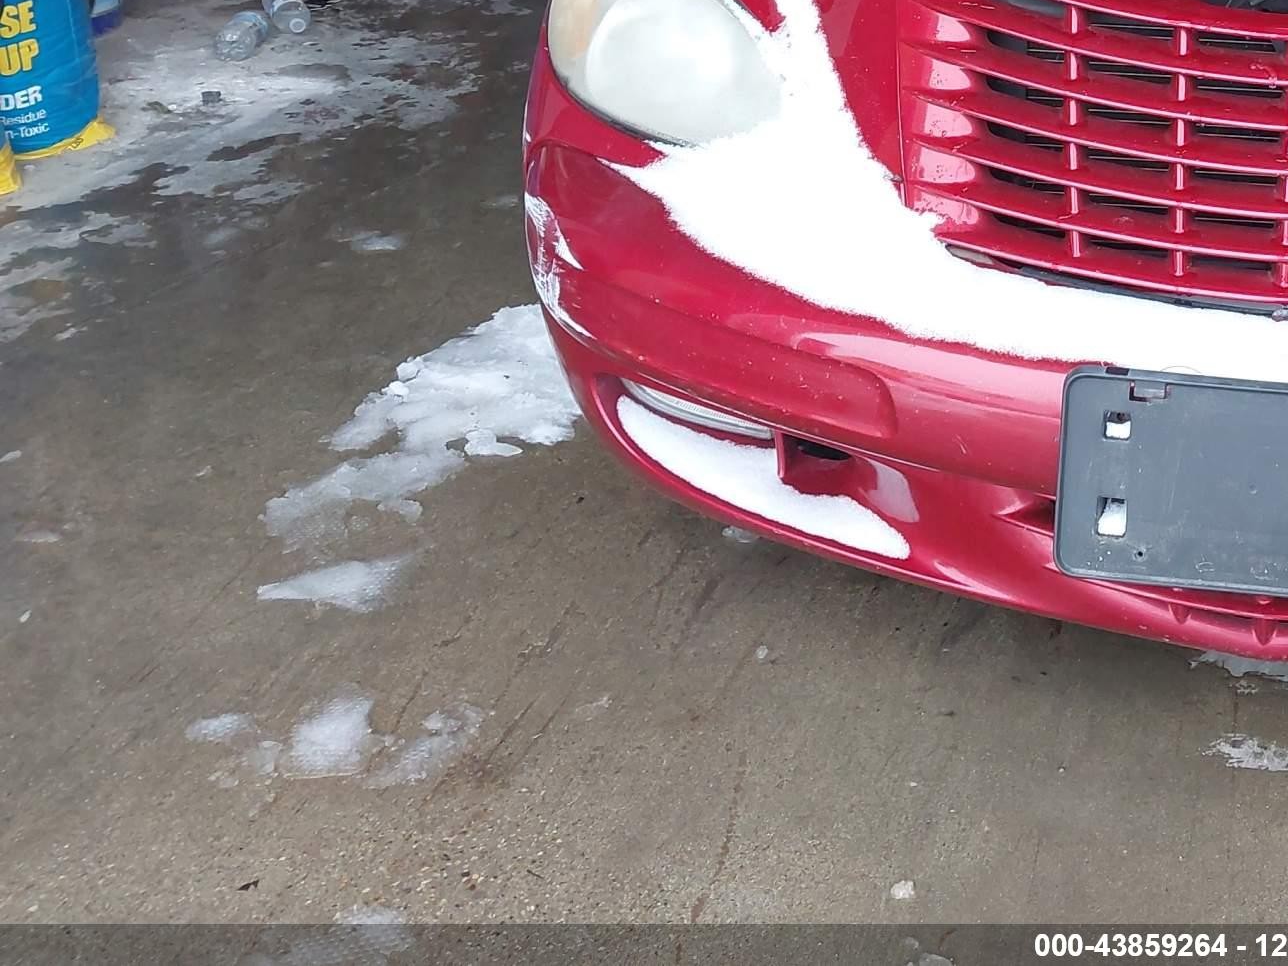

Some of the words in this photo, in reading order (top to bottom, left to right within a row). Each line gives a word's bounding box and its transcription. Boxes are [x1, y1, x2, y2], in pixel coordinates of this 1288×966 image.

[0, 0, 37, 39] SE
[0, 38, 39, 76] UP
[0, 85, 43, 111] DER
[0, 109, 47, 126] Residue
[4, 122, 51, 139] n-Toxic
